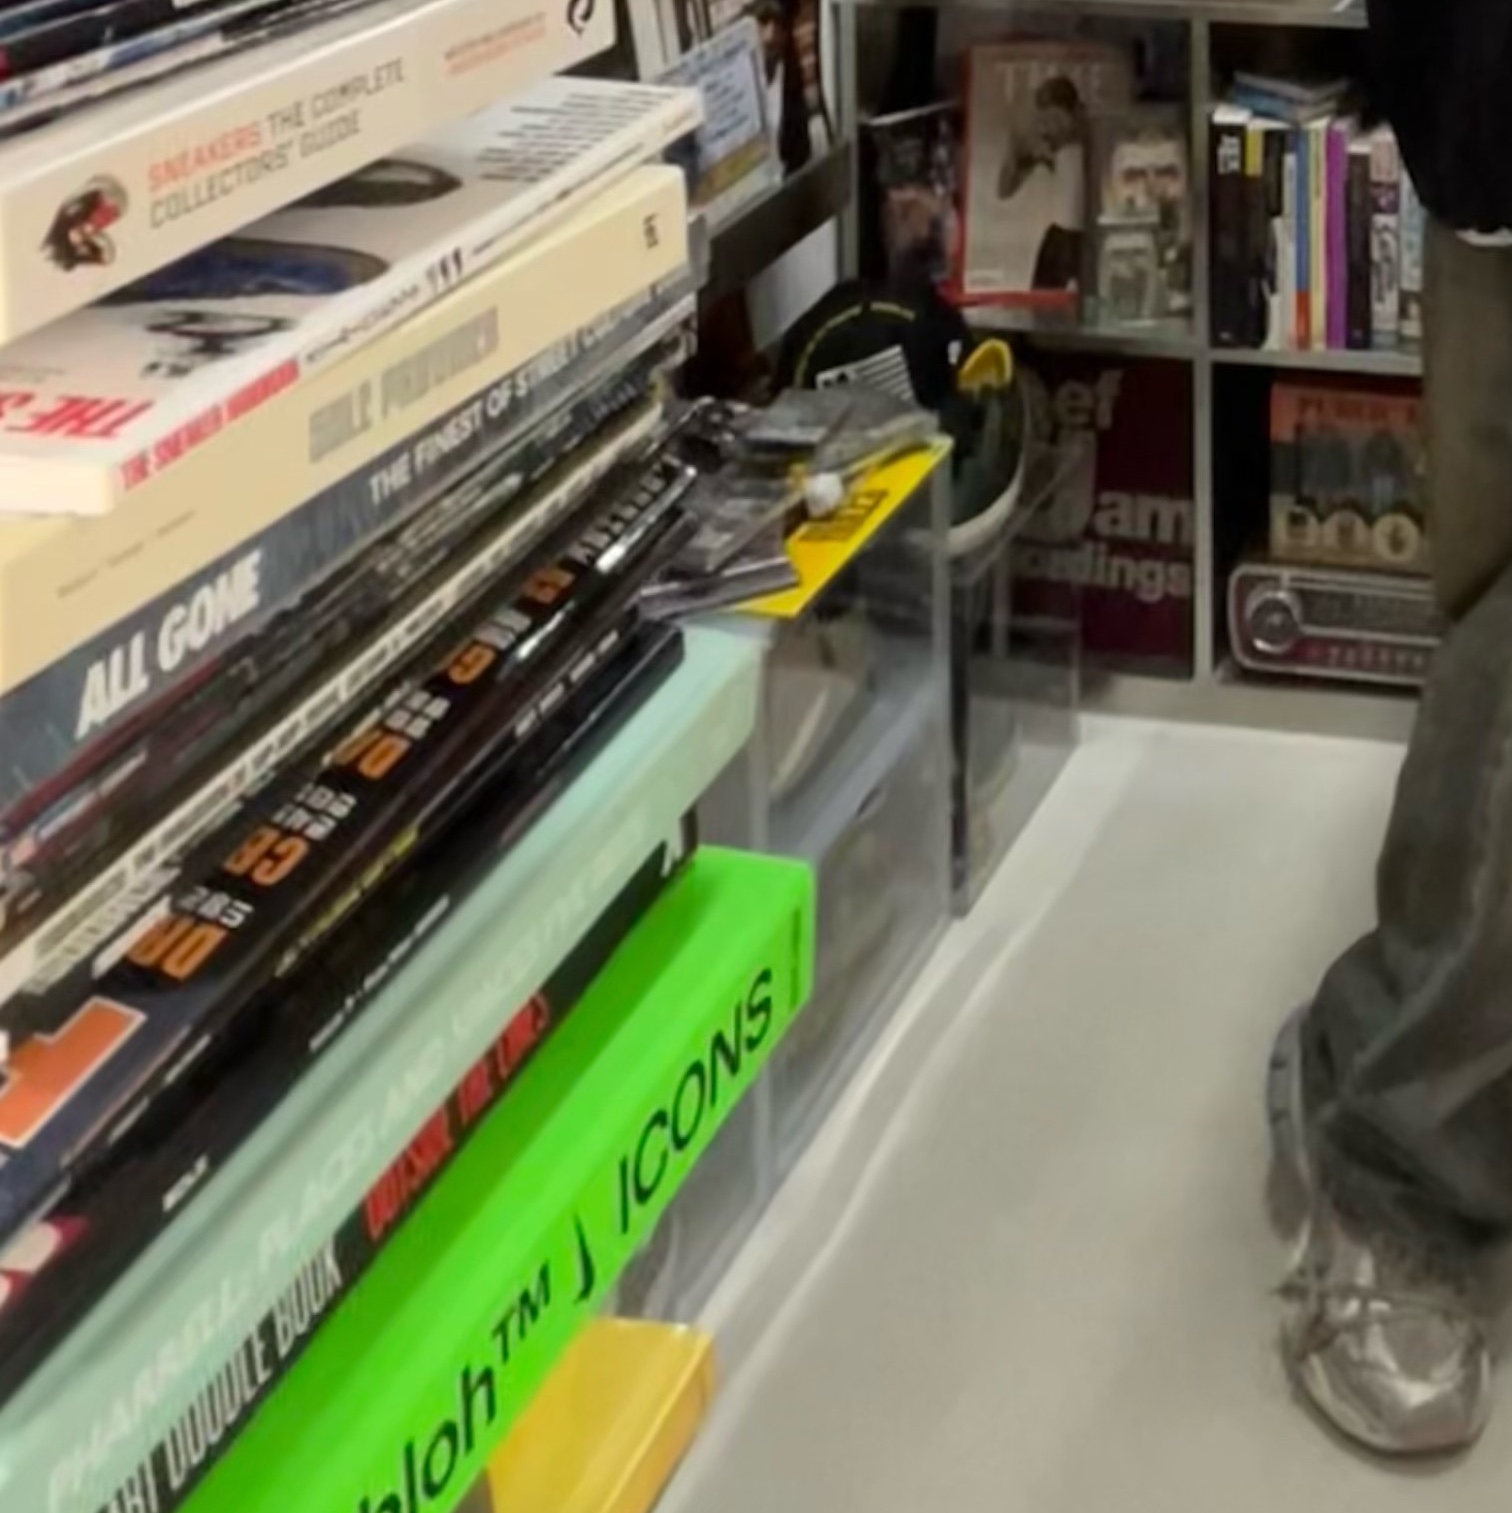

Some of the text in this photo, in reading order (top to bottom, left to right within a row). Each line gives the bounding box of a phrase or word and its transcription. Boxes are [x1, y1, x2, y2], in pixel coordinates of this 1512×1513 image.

[148, 56, 404, 194] SNEAKERS THE COMPLETE
[300, 107, 361, 159] GUIDE
[368, 451, 411, 506] THE
[412, 399, 483, 473] FINEST
[73, 630, 151, 742] ALL
[157, 547, 263, 673] GONE
[617, 967, 773, 1236] ICONS
[275, 1240, 344, 1360] BOOK
